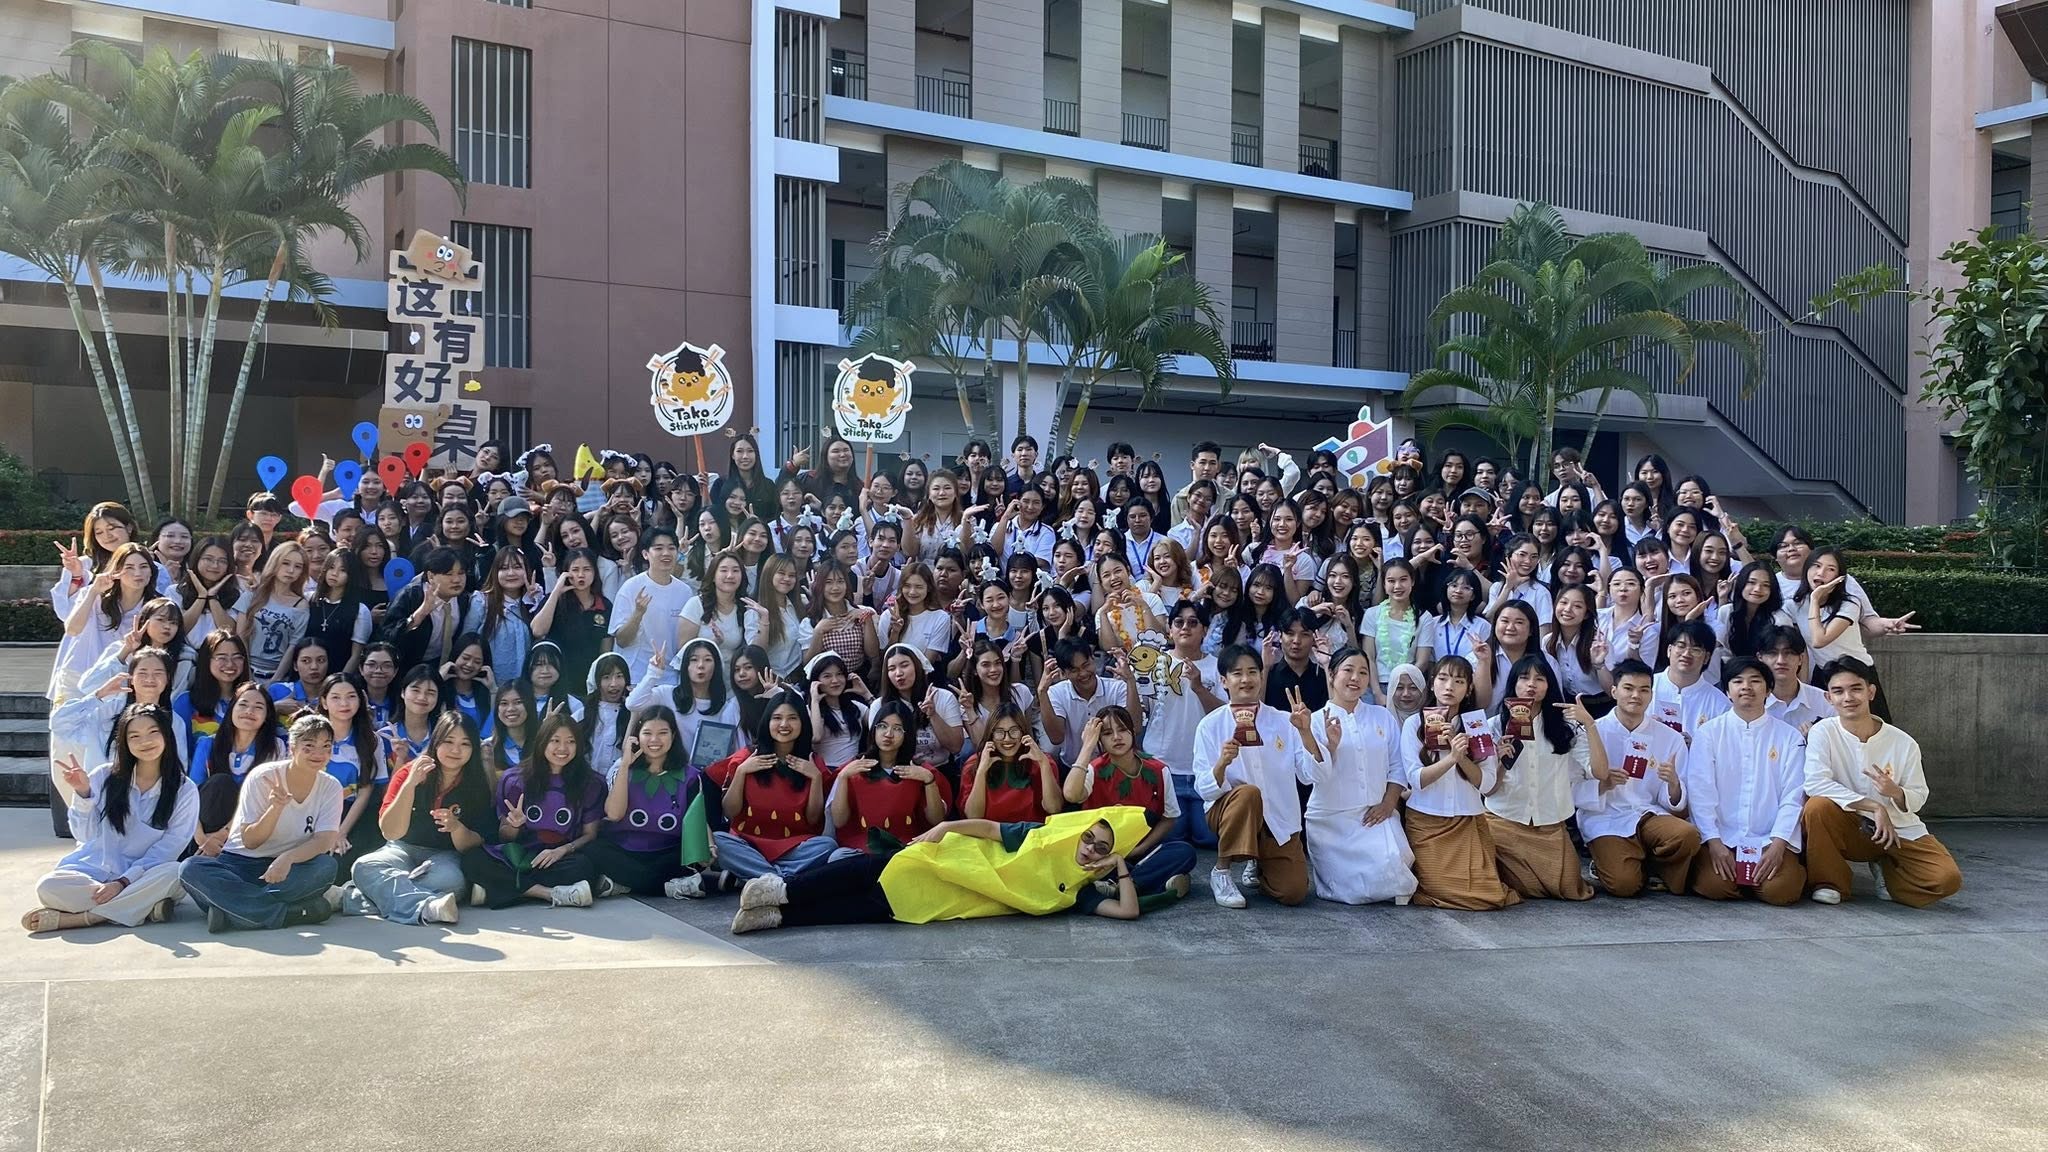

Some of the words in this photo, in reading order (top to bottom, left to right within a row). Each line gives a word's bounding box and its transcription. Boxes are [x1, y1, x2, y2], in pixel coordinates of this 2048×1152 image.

[396, 276, 444, 318] 这
[433, 319, 476, 364] 有
[393, 359, 452, 404] 好
[672, 406, 710, 421] Tako
[669, 420, 699, 431] Sticky
[700, 418, 720, 429] Rice
[857, 418, 882, 429] Tako
[842, 427, 873, 441] Sticky
[874, 429, 894, 440] Rice
